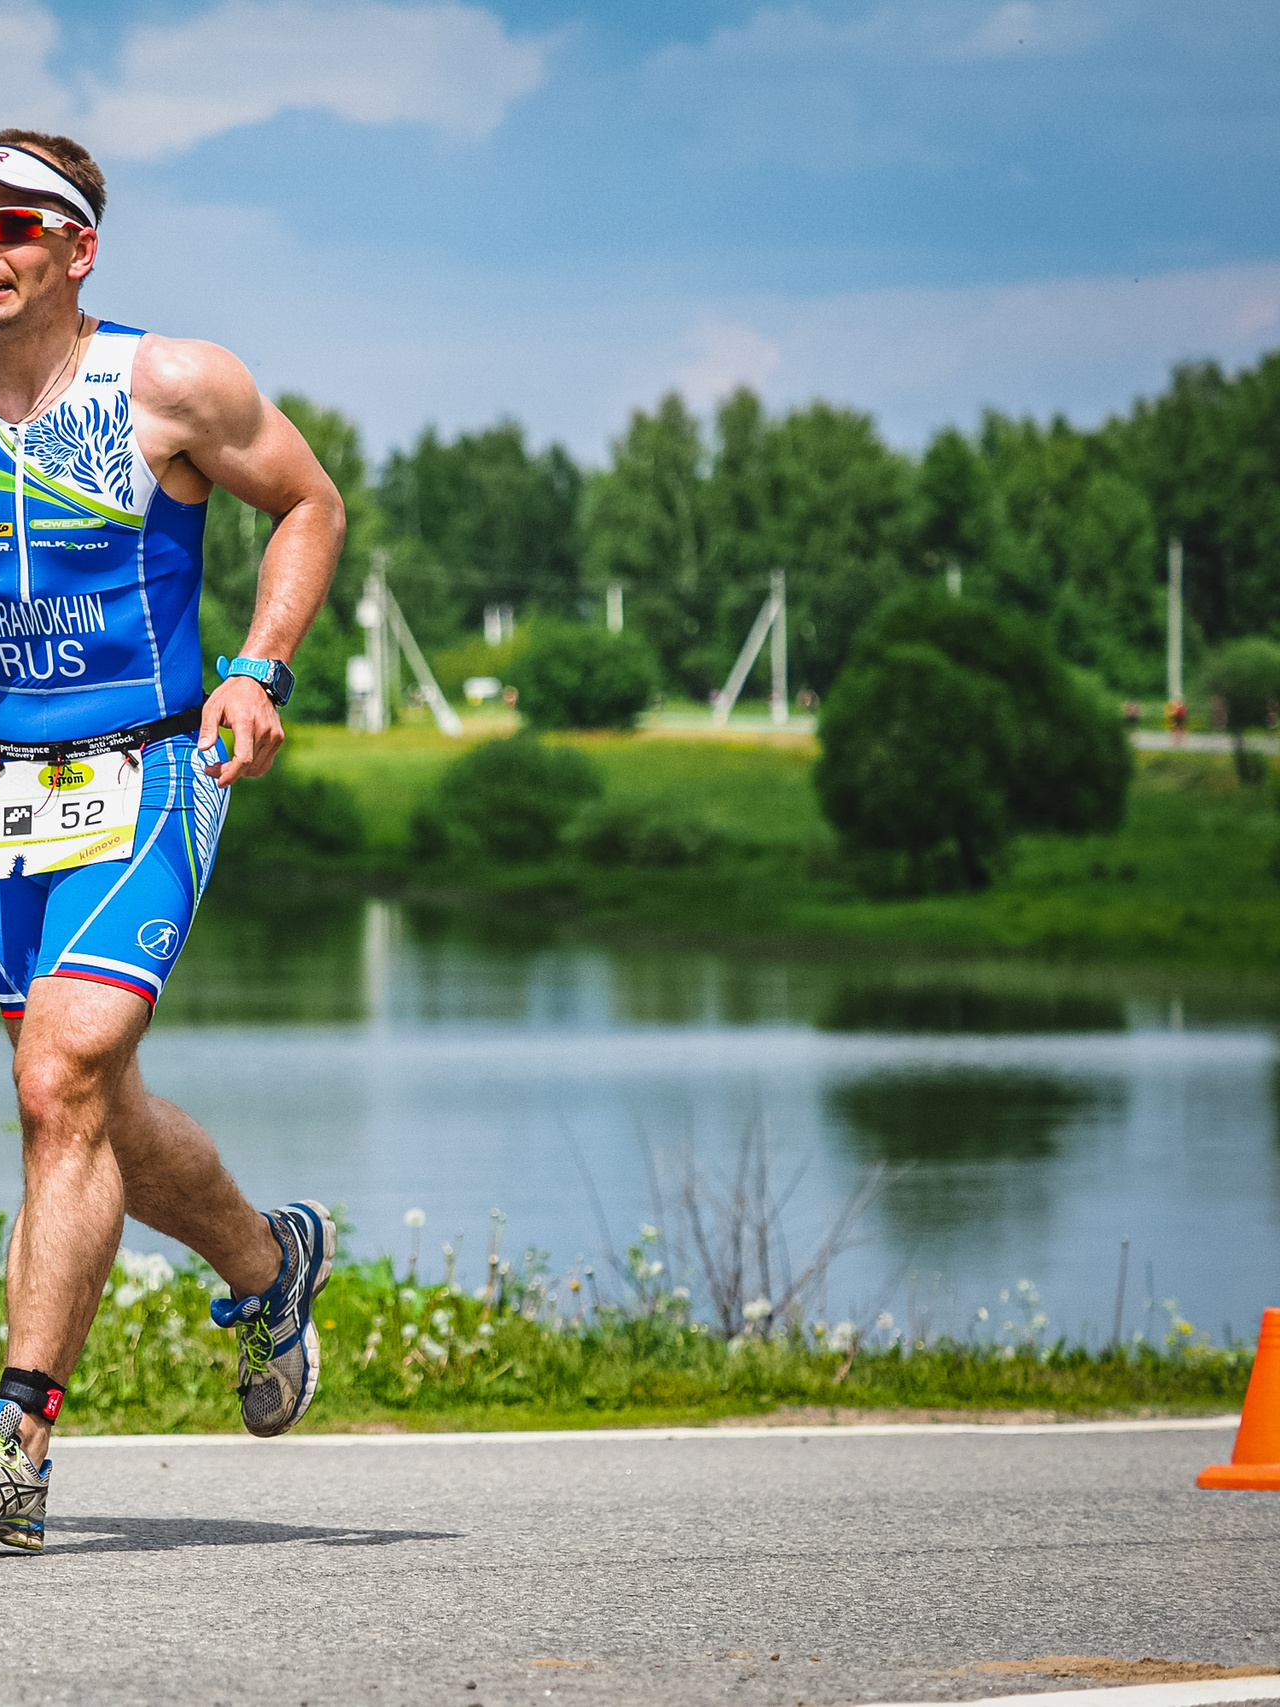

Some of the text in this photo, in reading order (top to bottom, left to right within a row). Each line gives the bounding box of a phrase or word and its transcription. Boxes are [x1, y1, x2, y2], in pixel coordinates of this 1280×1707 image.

[84, 372, 121, 383] kalas
[33, 518, 102, 528] POWERUP
[0, 744, 51, 755] performance
[6, 751, 35, 761] recovery
[60, 800, 105, 829] 52
